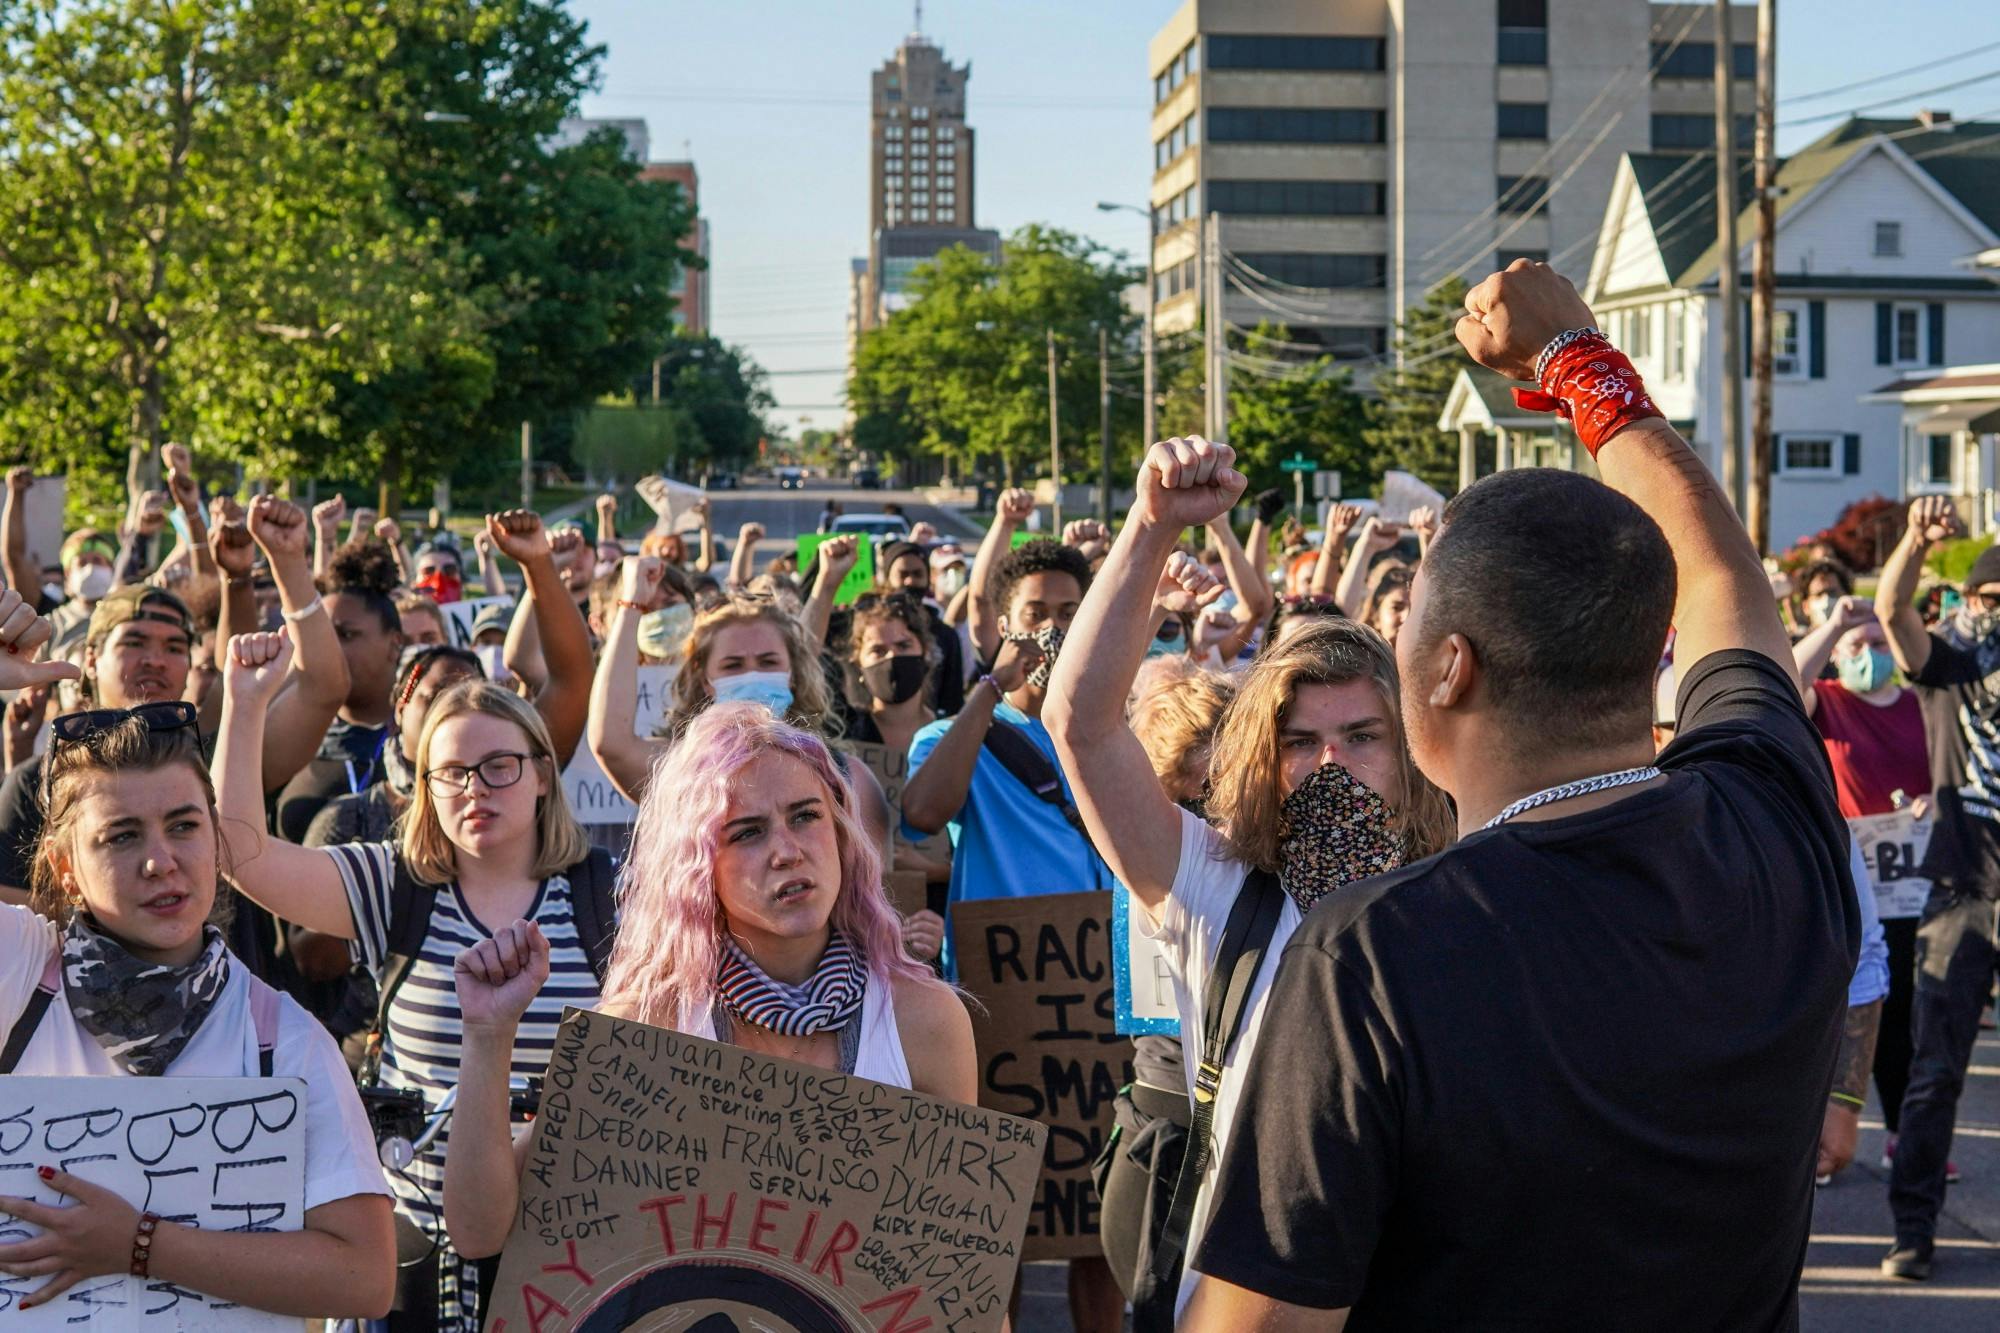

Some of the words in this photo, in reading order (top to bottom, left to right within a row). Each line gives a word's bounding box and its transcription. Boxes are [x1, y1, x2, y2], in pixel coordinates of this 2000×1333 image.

[985, 918, 1113, 984] RAC
[574, 1107, 708, 1162] DEBORAH
[858, 1085, 901, 1147] SAM
[899, 1095, 989, 1135] JOSHUA
[996, 1118, 1036, 1147] BEAL
[573, 1149, 700, 1191] DANNER
[722, 1124, 879, 1192] FRANCISCO
[902, 1122, 1016, 1202] MARK
[522, 1189, 598, 1230] KEITH
[750, 1171, 832, 1207] SERNA
[880, 1164, 1007, 1233] DUGGAN
[539, 1214, 620, 1246] SCOTT
[639, 1191, 860, 1287] THEIR
[873, 1214, 916, 1235] KIRK
[922, 1222, 1015, 1257] FIGUEROA
